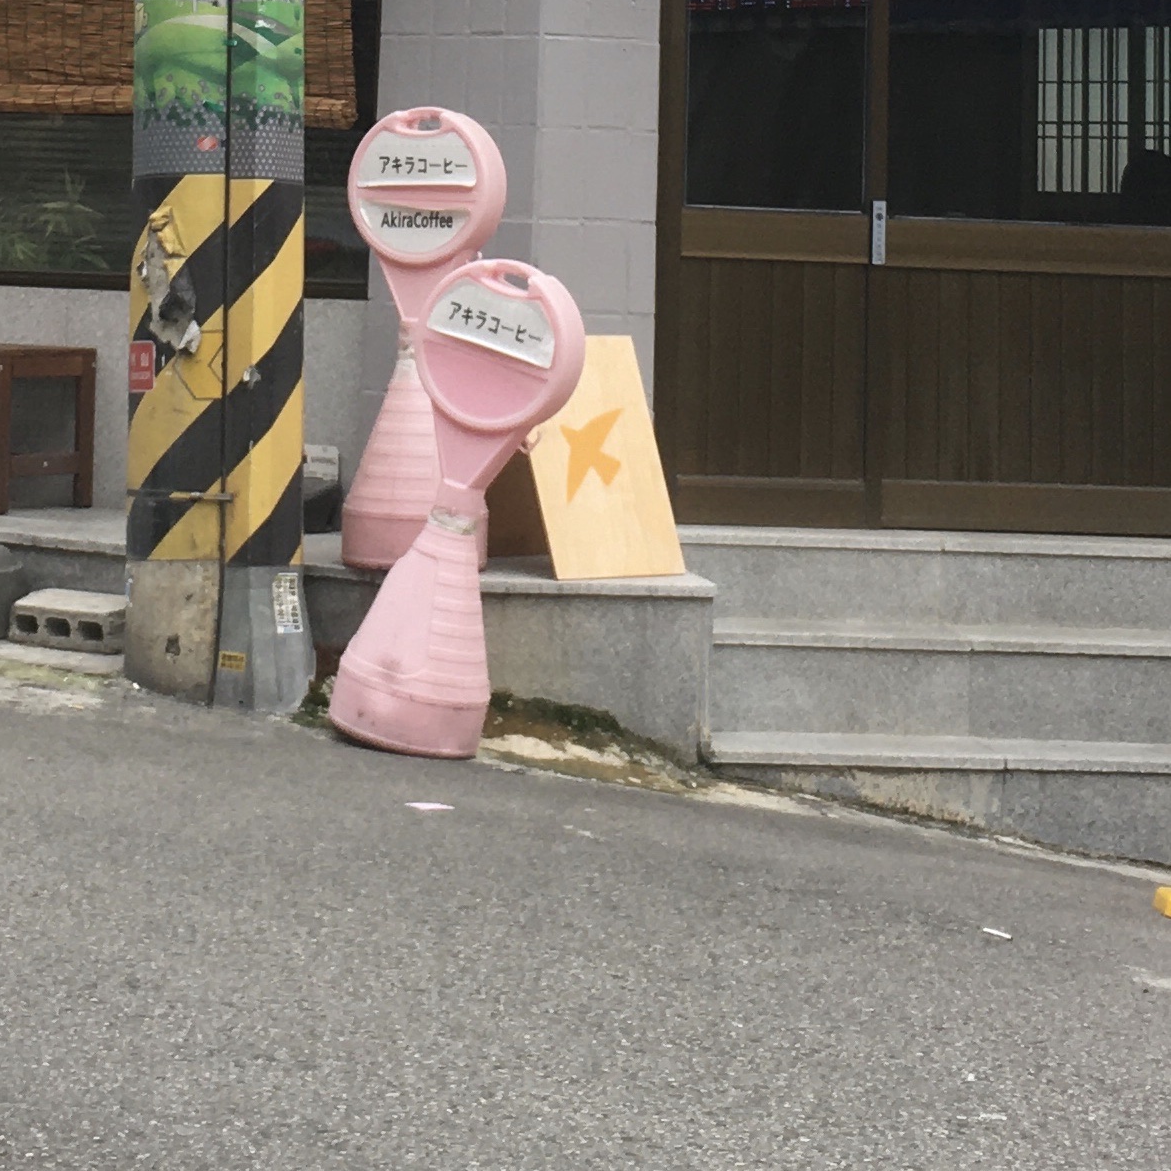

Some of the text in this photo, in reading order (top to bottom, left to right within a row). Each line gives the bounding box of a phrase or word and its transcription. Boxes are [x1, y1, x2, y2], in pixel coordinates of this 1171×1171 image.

[378, 156, 468, 175] アキラコーヒー
[380, 212, 453, 229] AkiraCoffee
[448, 300, 544, 344] アキラコーヒー
